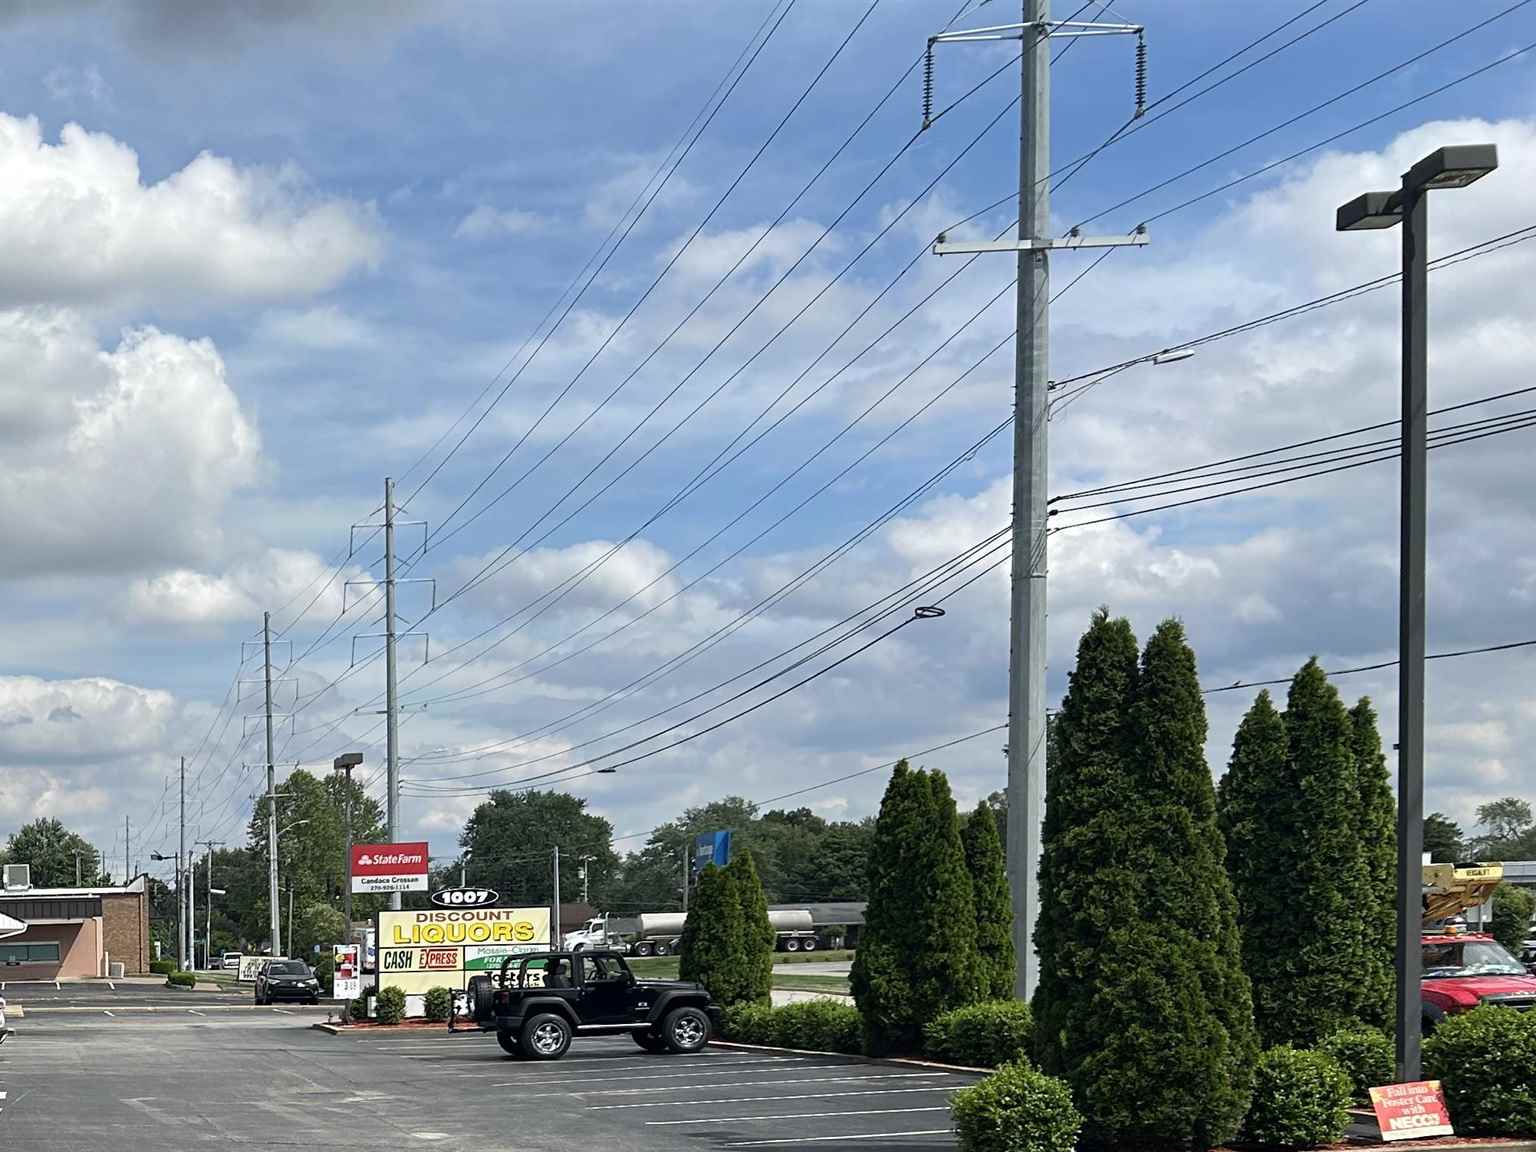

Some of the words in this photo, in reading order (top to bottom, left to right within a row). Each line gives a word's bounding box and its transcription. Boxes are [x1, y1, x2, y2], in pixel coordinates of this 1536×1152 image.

[441, 891, 489, 904] 1007
[416, 911, 513, 923] DISCOUNT
[393, 922, 535, 944] LIQUORS
[384, 951, 413, 969] CASH
[419, 949, 458, 968] EXPRESS
[1386, 1087, 1407, 1097] Fall
[1401, 1105, 1425, 1115] with
